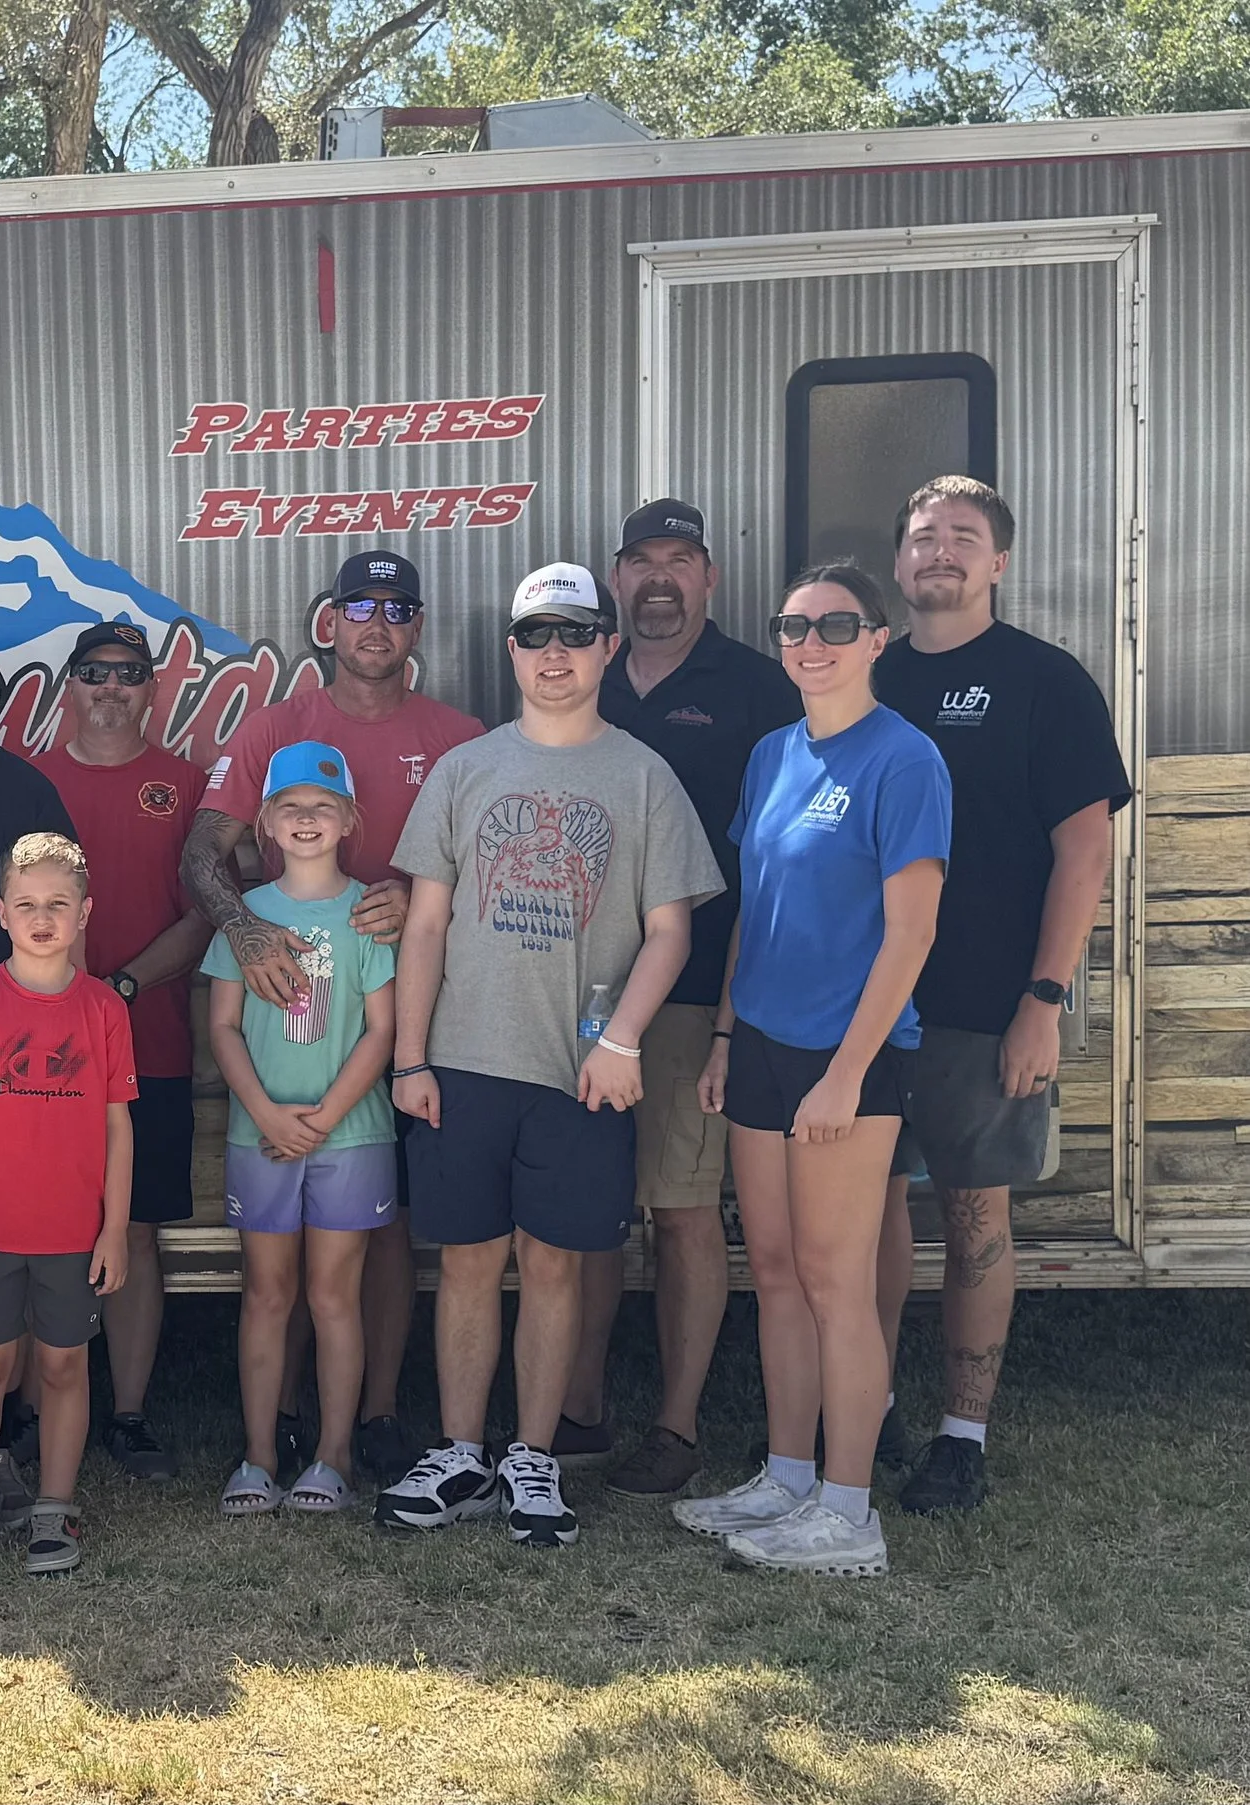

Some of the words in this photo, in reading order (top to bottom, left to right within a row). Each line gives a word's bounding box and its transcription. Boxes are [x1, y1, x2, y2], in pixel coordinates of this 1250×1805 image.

[168, 394, 546, 457] PARTIES
[178, 482, 537, 542] EVENTS
[369, 561, 397, 570] OKIE
[500, 888, 572, 919] QUALIT
[493, 908, 574, 941] CLOTHIN
